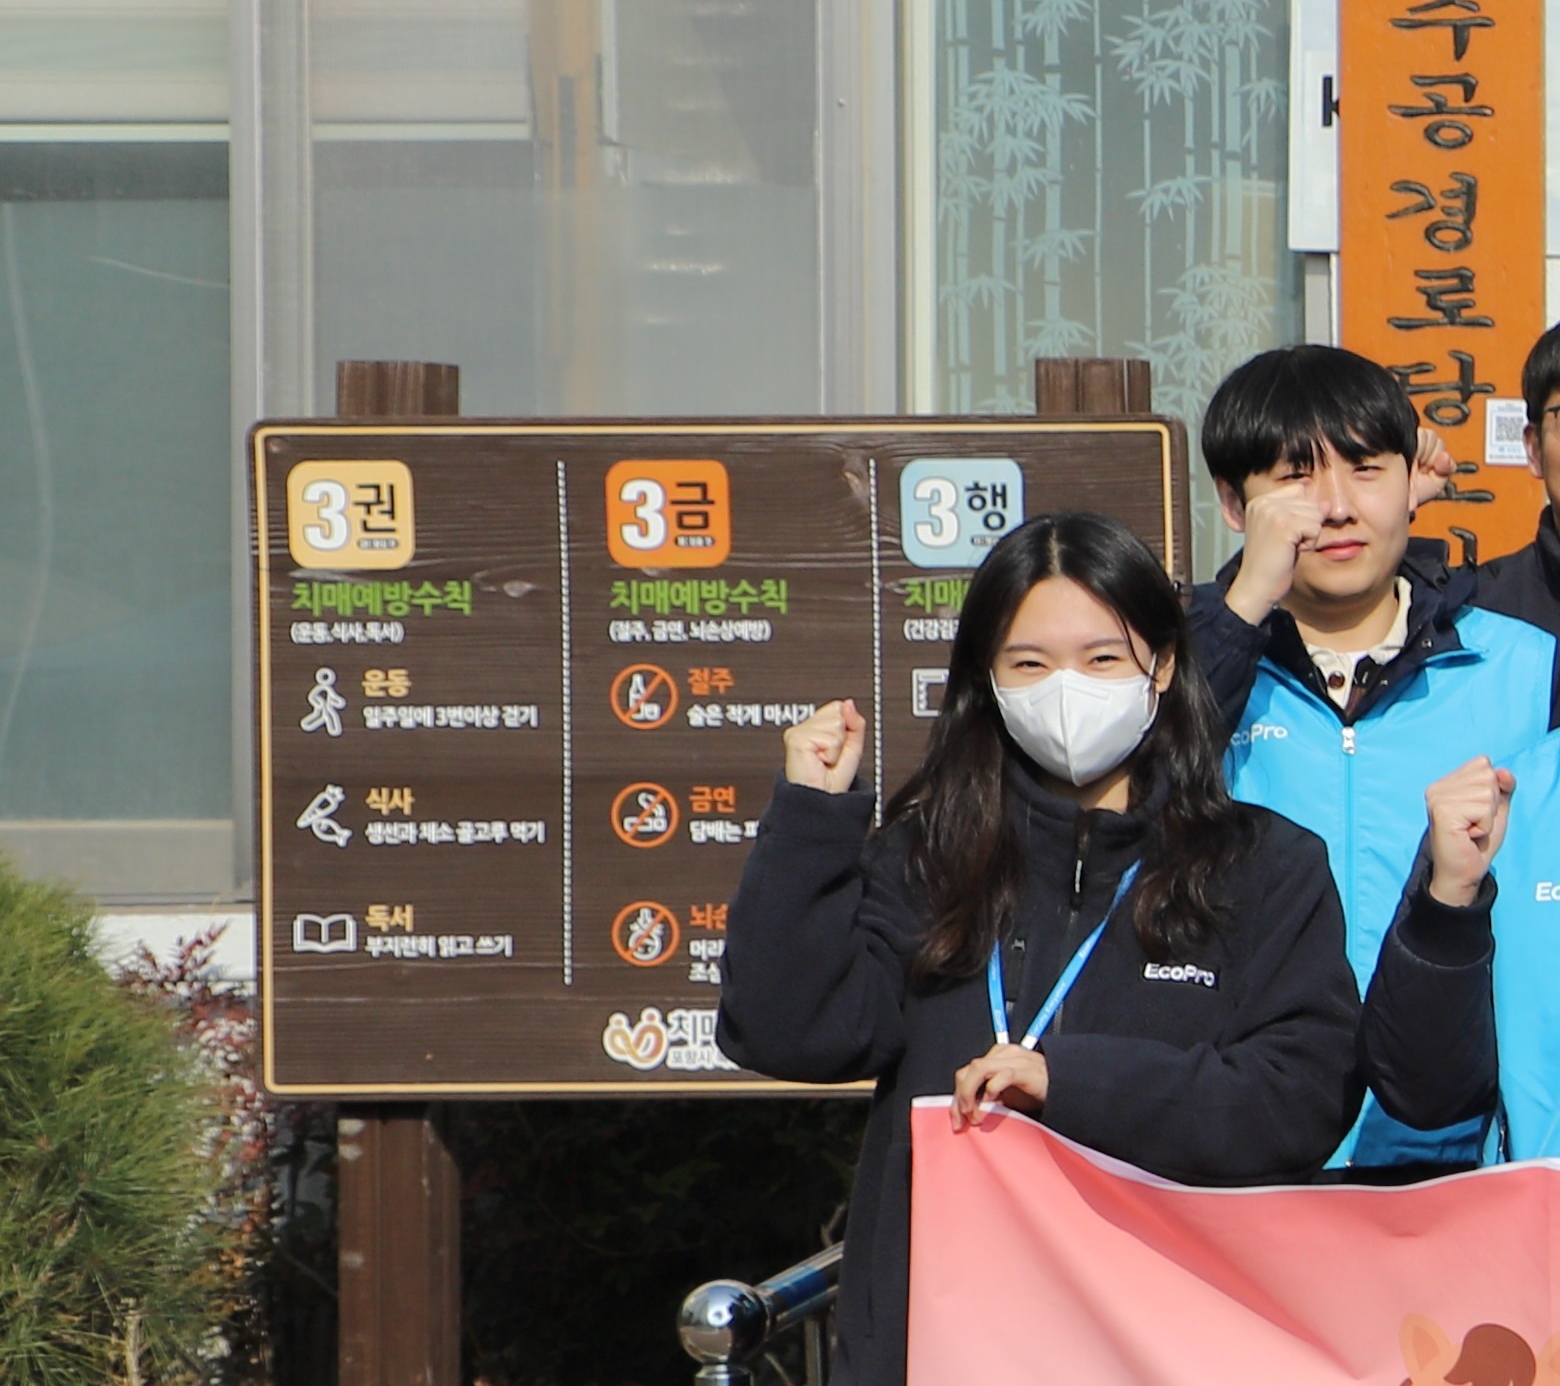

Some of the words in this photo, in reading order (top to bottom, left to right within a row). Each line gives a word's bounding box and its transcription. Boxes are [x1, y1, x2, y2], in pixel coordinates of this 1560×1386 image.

[303, 479, 396, 550] 3권
[620, 478, 715, 550] 3금
[914, 477, 1007, 548] 3행
[291, 580, 473, 616] 치매예방수칙
[610, 579, 789, 615] 치매예방수칙
[904, 579, 971, 613] 치매
[362, 669, 412, 698] 운동
[687, 667, 735, 696] 절주
[362, 705, 434, 729] 일주일에
[501, 704, 539, 728] 걷기
[687, 703, 724, 727] 술은
[725, 703, 762, 727] 적게
[763, 703, 817, 725] 마시기
[1231, 723, 1288, 746] coPro
[365, 787, 415, 816] 식사
[689, 786, 737, 813] 금연
[364, 821, 417, 845] 생선과
[419, 821, 456, 844] 채소
[456, 821, 507, 845] 골고루
[509, 820, 546, 844] 먹기
[689, 819, 742, 843] 담배는
[365, 904, 414, 932] 독서
[364, 935, 437, 958] 부지런히
[437, 935, 474, 958] 읽고
[475, 934, 514, 958] 쓰기
[1143, 962, 1216, 988] EcoPro
[671, 1048, 711, 1065] 포항시
